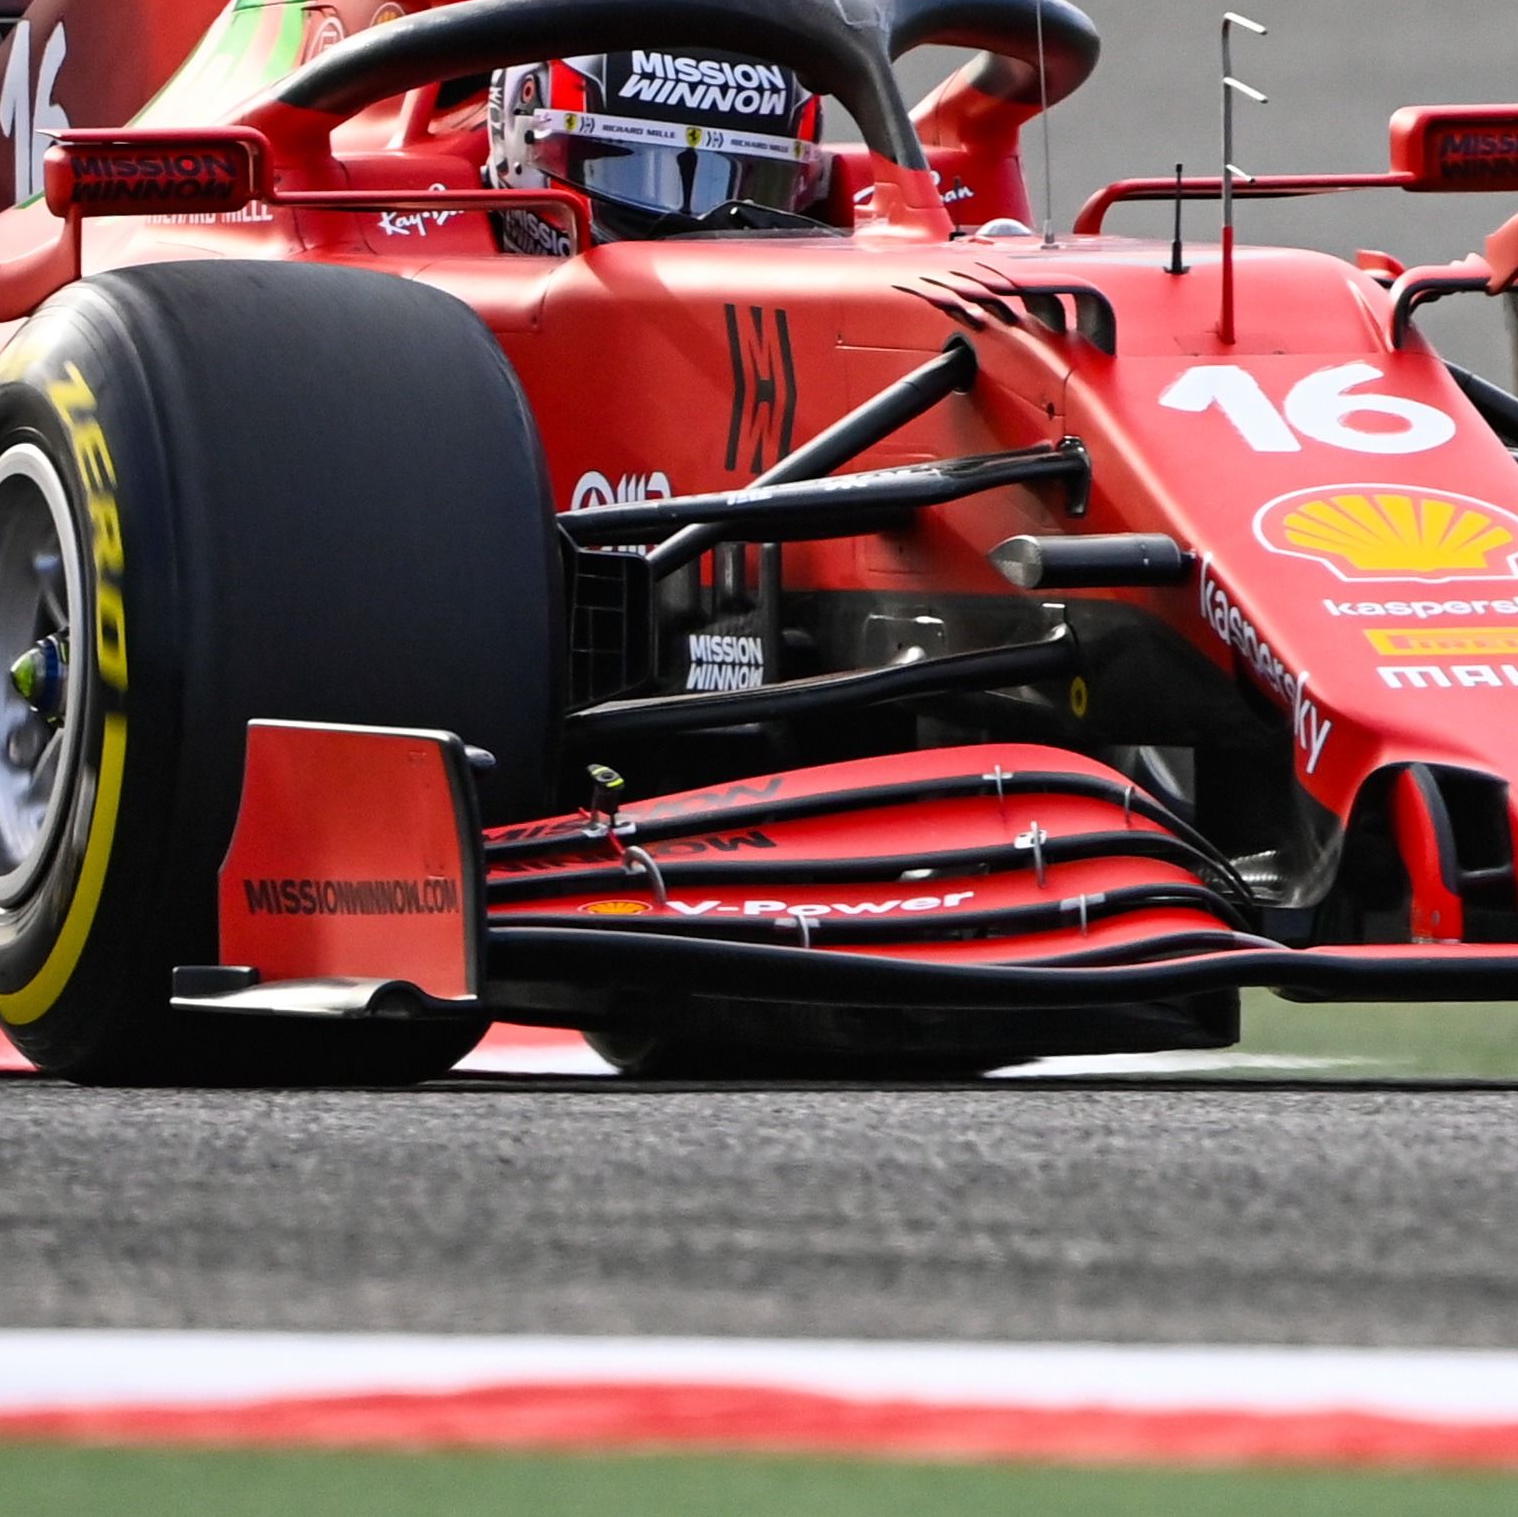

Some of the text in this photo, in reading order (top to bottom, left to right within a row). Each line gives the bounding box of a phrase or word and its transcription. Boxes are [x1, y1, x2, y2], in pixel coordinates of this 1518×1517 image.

[632, 50, 784, 90] MISSION
[618, 75, 786, 115] WINNOW
[602, 123, 643, 136] RICHARD
[71, 154, 237, 179] MISSION
[70, 179, 234, 203] WINNOW
[1158, 361, 1456, 455] 16
[689, 634, 764, 665] MISSION
[686, 663, 764, 690] WINNOW
[243, 878, 460, 916] MISSIONWINNOW.COM
[667, 890, 975, 916] V-Power
